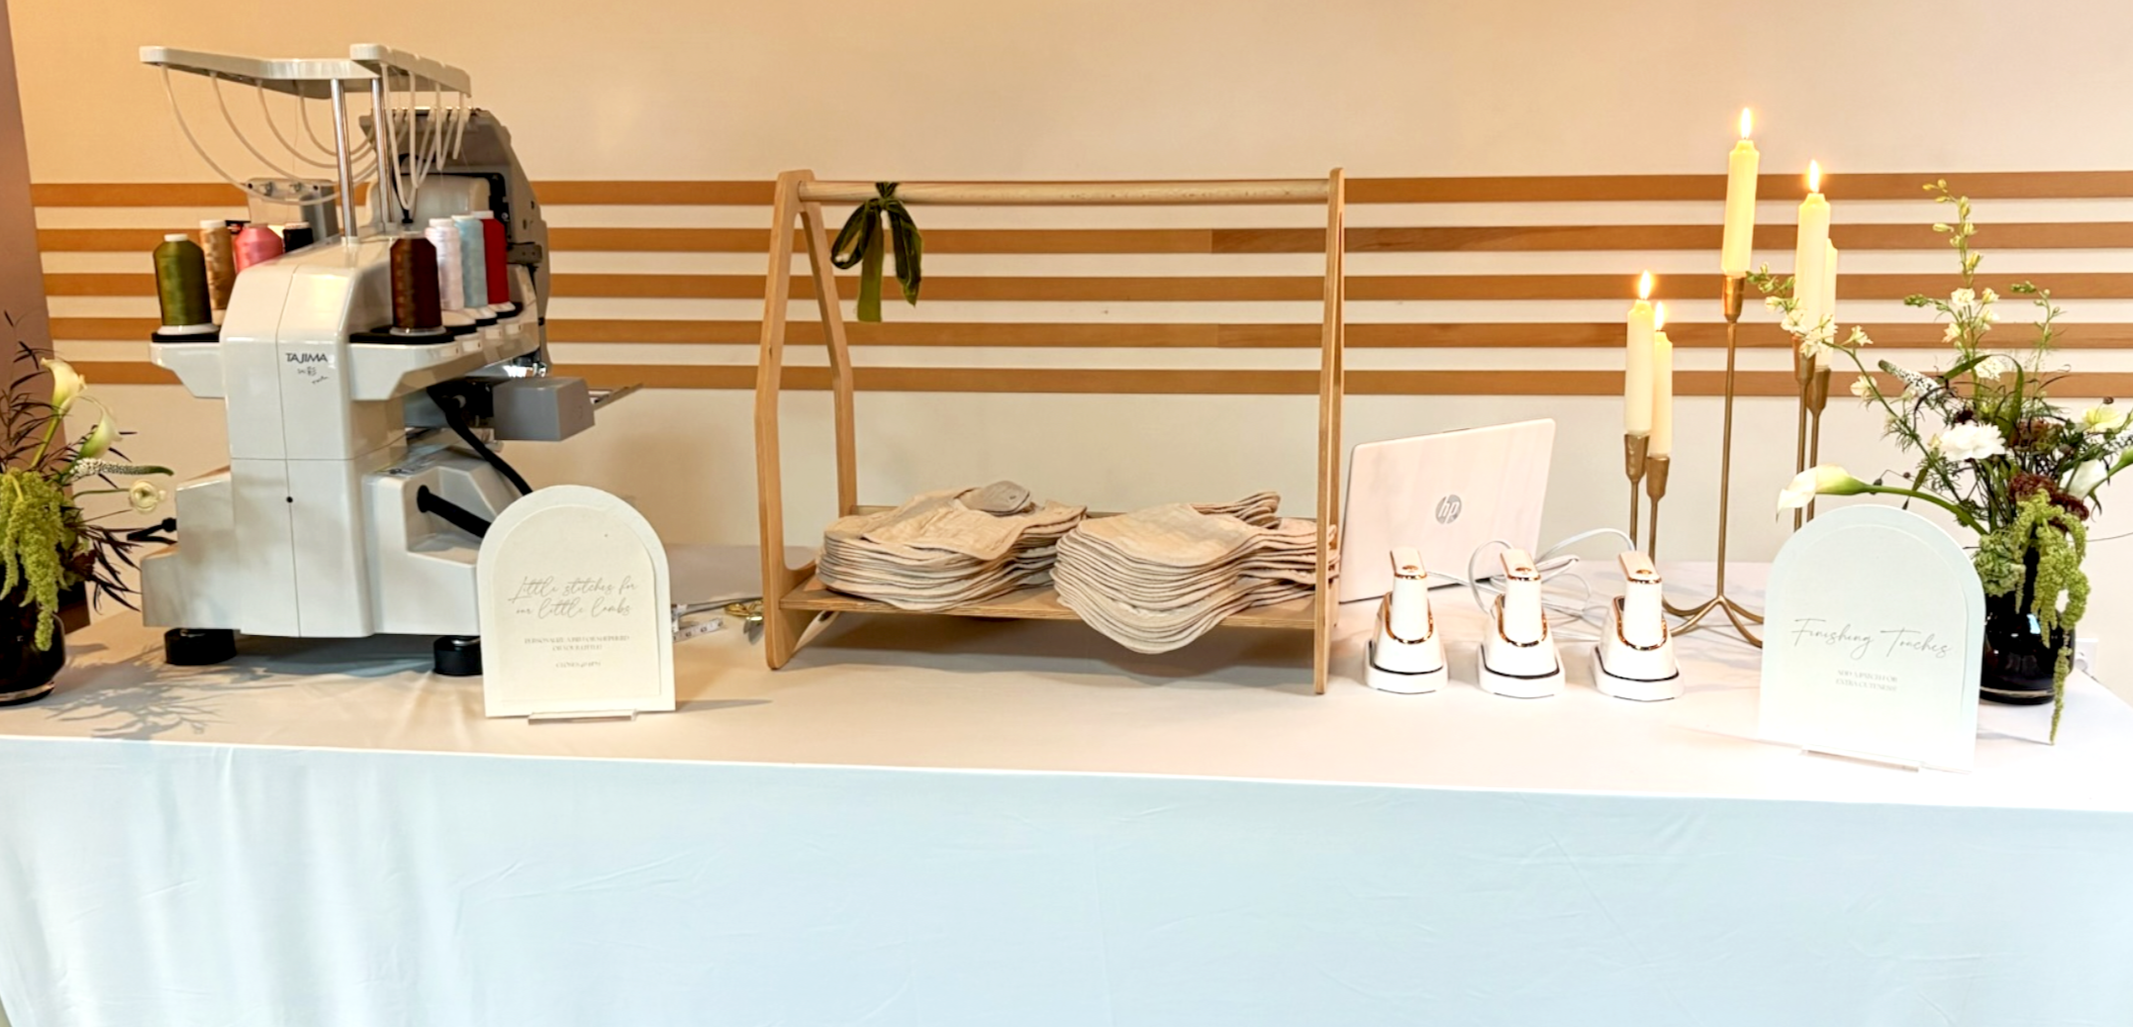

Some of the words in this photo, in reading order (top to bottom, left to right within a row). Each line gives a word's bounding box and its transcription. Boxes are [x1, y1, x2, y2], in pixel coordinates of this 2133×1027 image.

[285, 352, 328, 364] TAJIMA
[1435, 494, 1462, 525] hp
[507, 575, 559, 603] Little
[562, 576, 614, 597] stitches
[618, 574, 638, 595] for
[538, 596, 583, 619] little
[590, 596, 631, 618] lambs
[1791, 617, 1874, 661] Finishing
[1879, 627, 1952, 658] Touches
